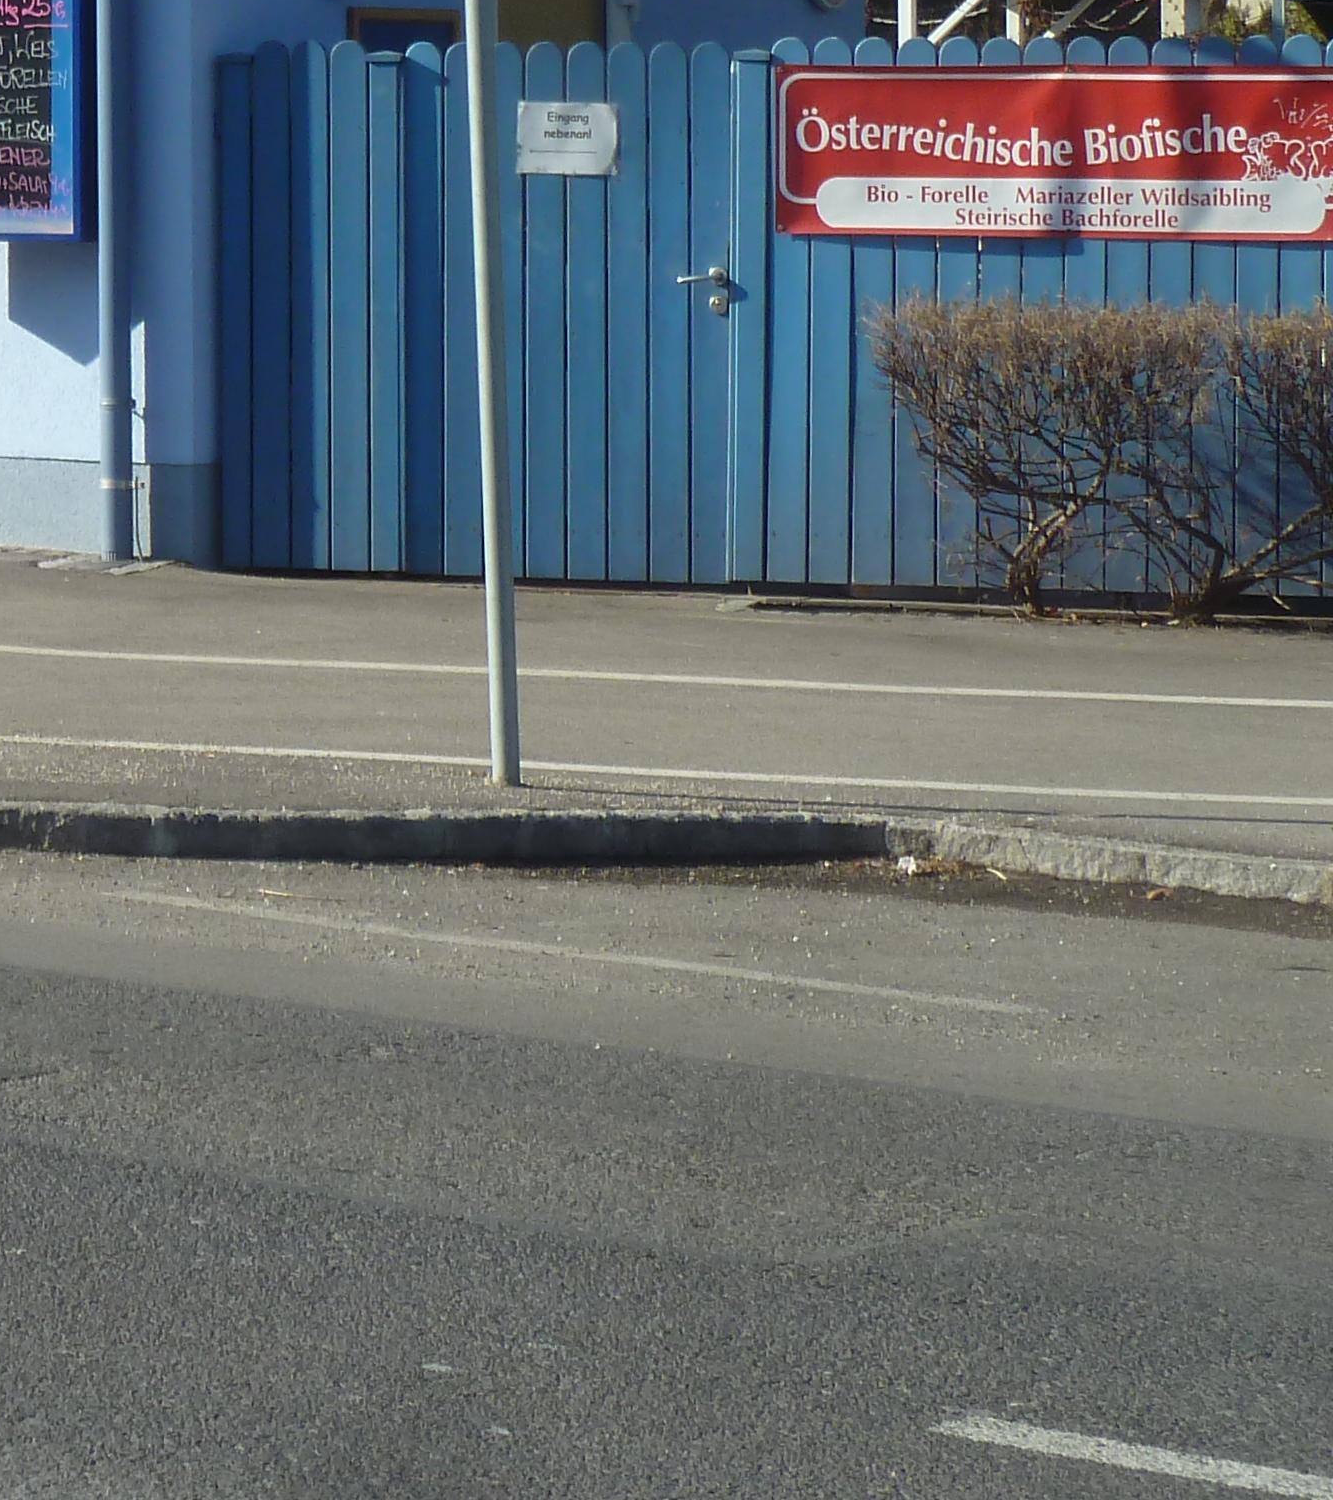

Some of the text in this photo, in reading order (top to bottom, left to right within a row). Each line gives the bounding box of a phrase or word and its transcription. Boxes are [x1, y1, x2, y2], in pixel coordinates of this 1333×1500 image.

[547, 112, 590, 125] Eingang
[795, 107, 1247, 168] Österreichische Biofische
[866, 185, 899, 204] Bio
[920, 185, 989, 205] Forelle
[1016, 186, 1133, 207] Mariazeller
[1140, 187, 1271, 212] Wildsaibling
[955, 206, 1179, 229] Steirische Bachforelle
